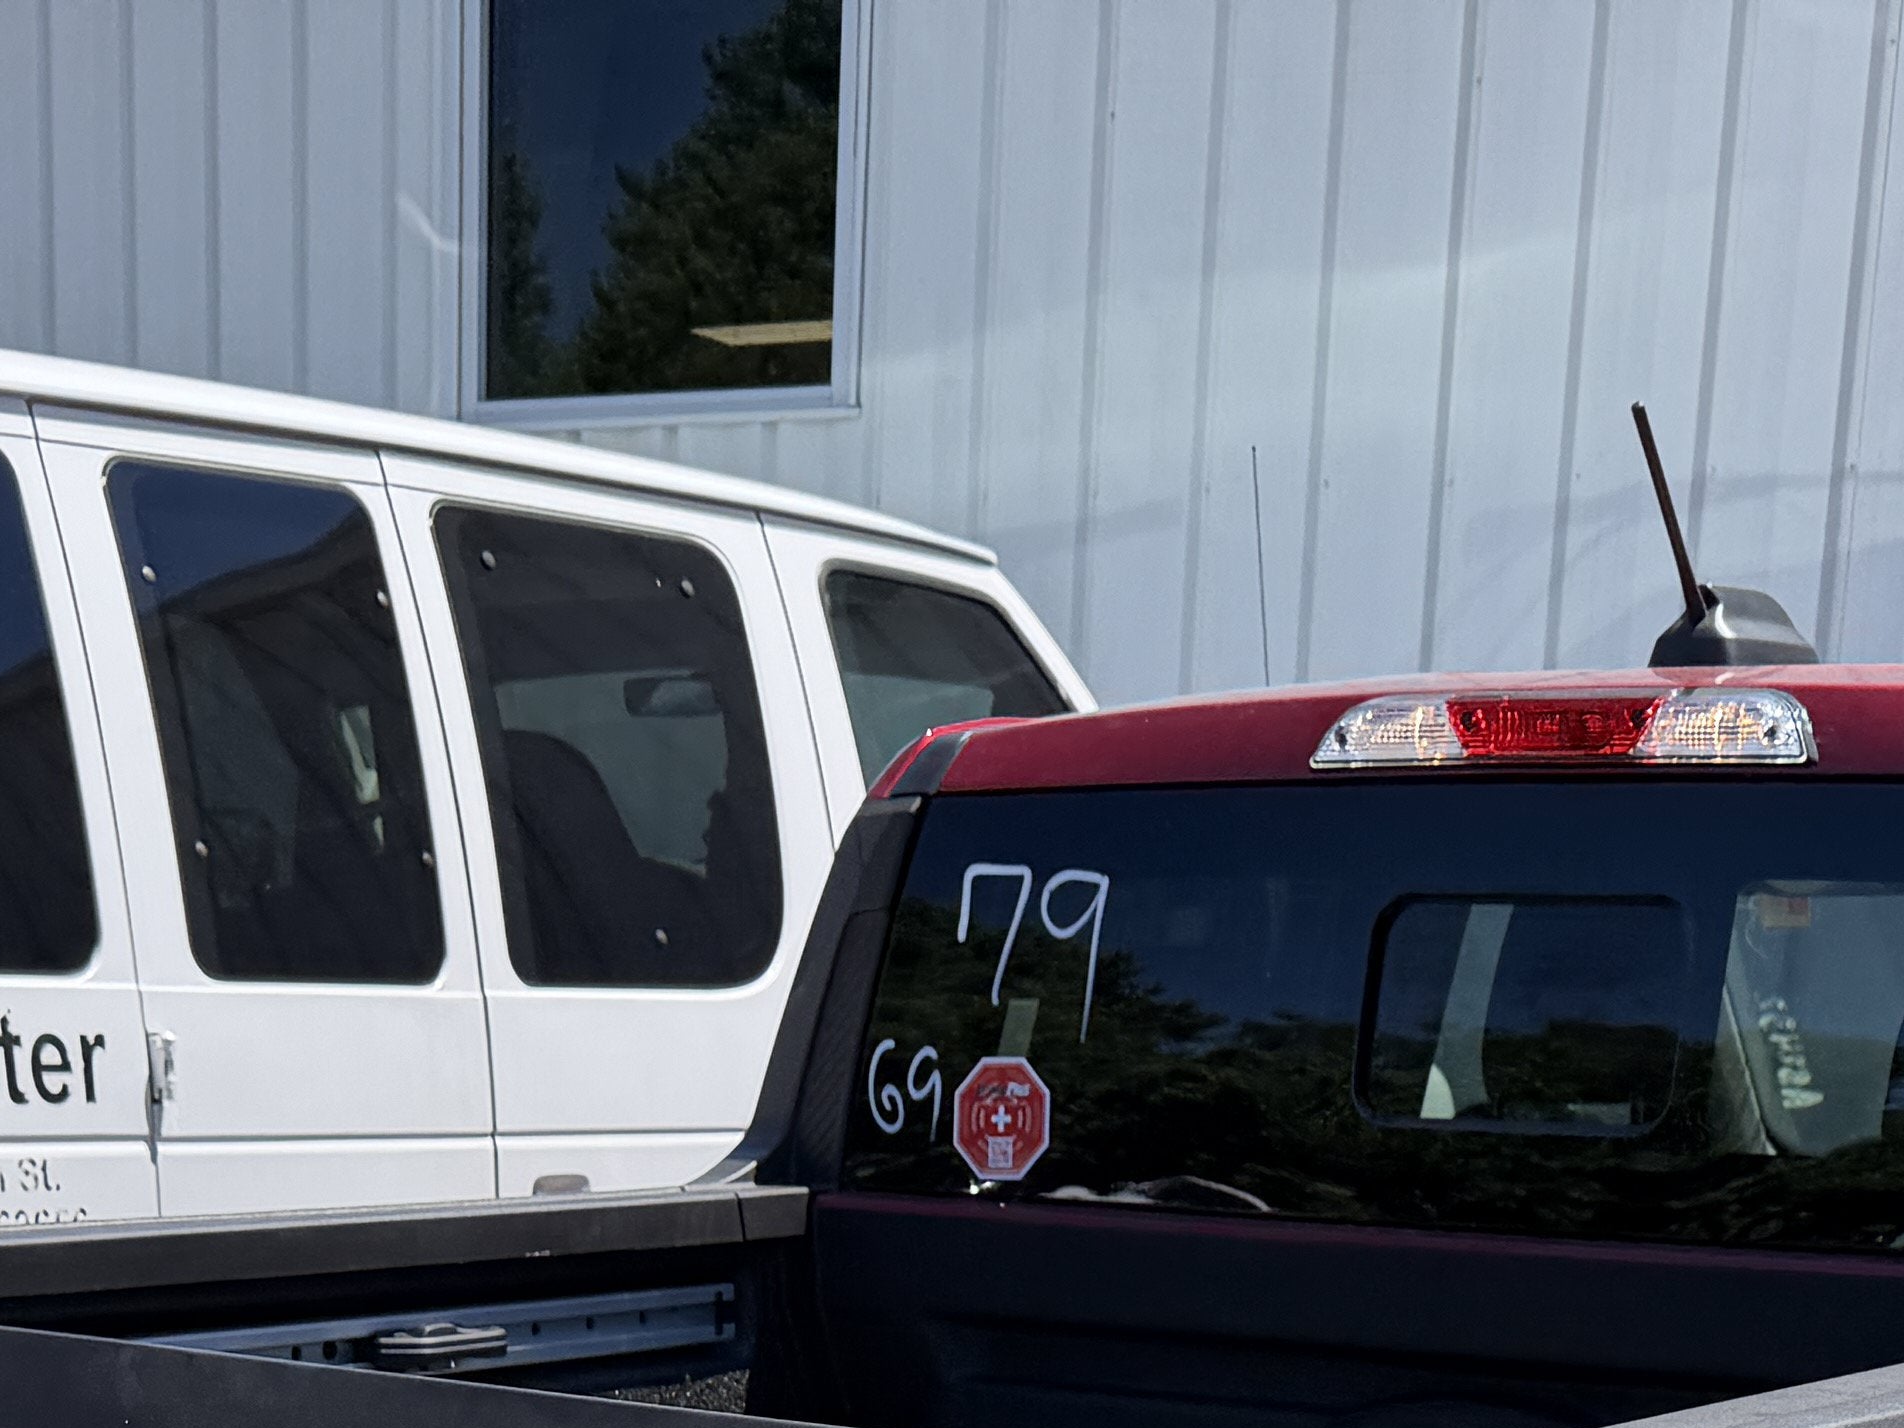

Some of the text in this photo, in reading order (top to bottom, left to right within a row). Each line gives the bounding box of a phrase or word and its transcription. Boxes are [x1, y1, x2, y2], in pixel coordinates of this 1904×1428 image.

[957, 861, 1110, 1043] 79
[868, 1038, 942, 1141] 69
[17, 1158, 61, 1193] St.
